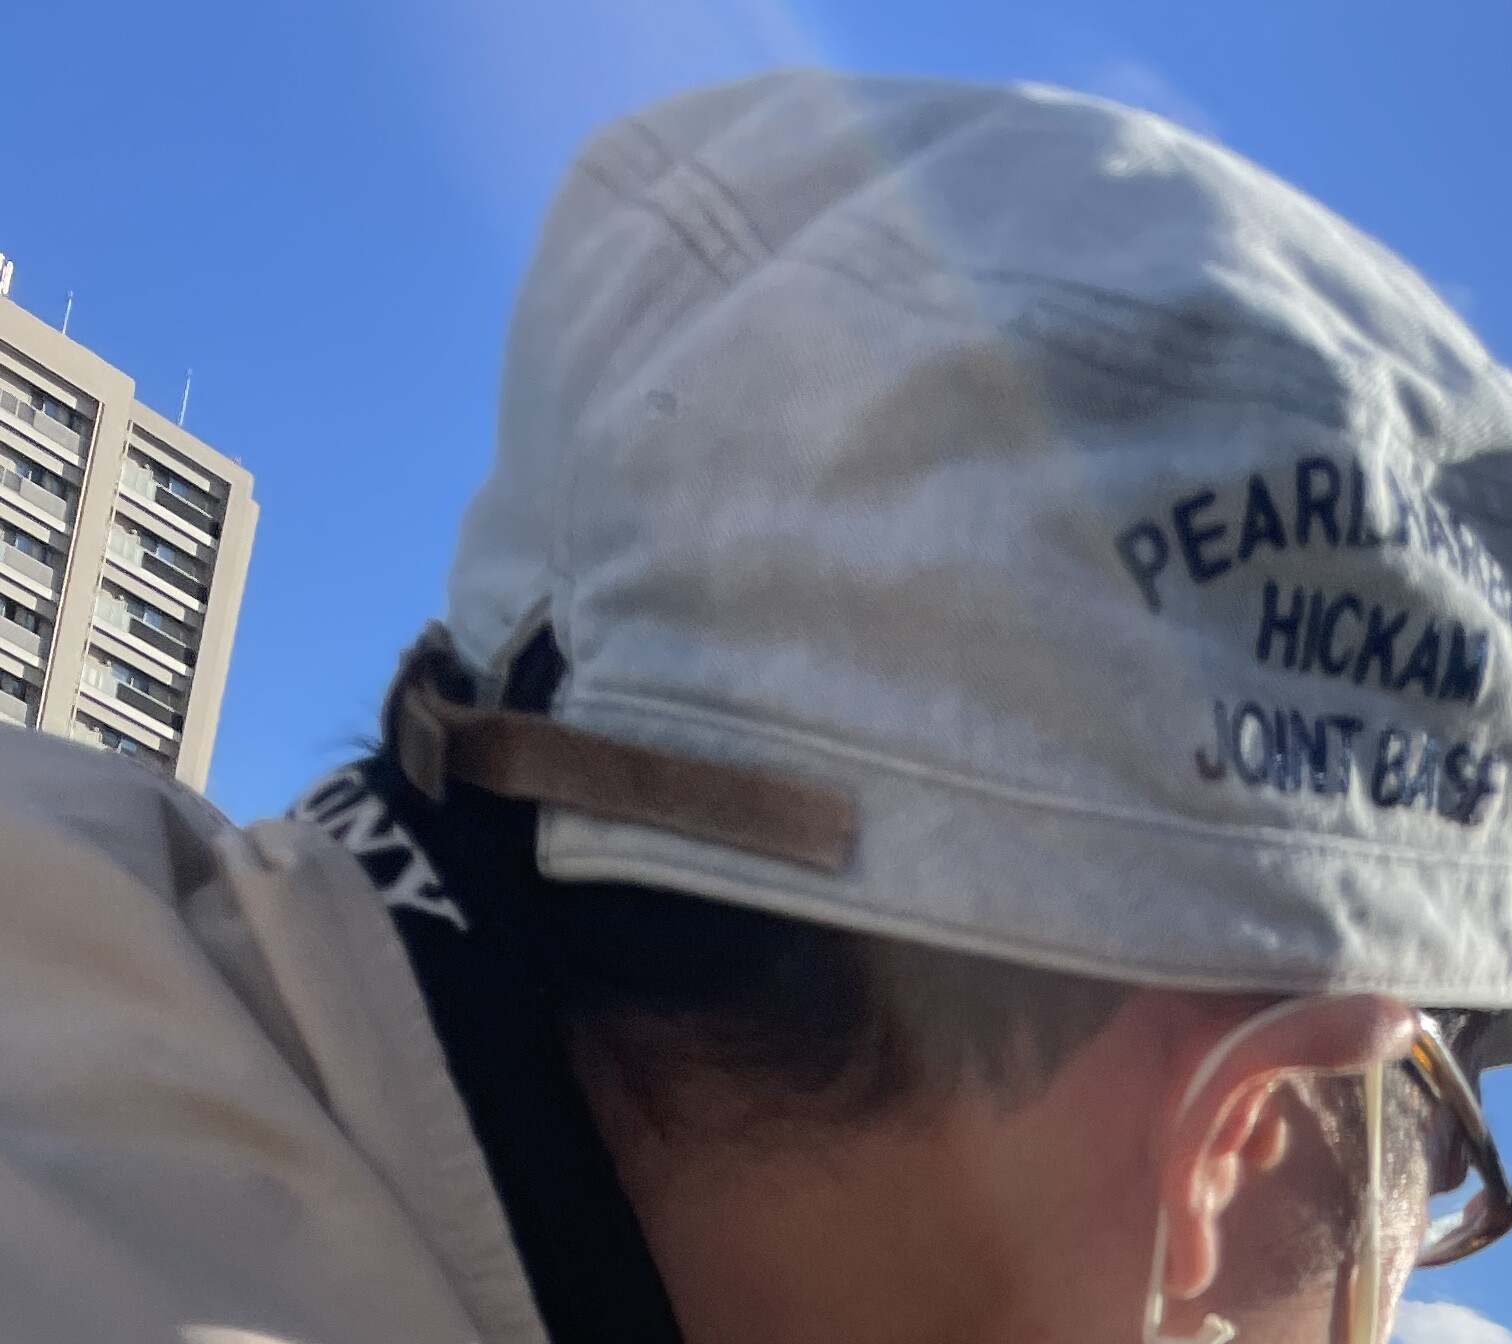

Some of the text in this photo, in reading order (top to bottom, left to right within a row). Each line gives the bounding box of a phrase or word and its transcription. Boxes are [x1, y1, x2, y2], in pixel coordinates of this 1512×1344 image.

[1113, 455, 1392, 615] PEARL
[1256, 580, 1490, 705] HICKAM
[1195, 700, 1363, 794] JOINT
